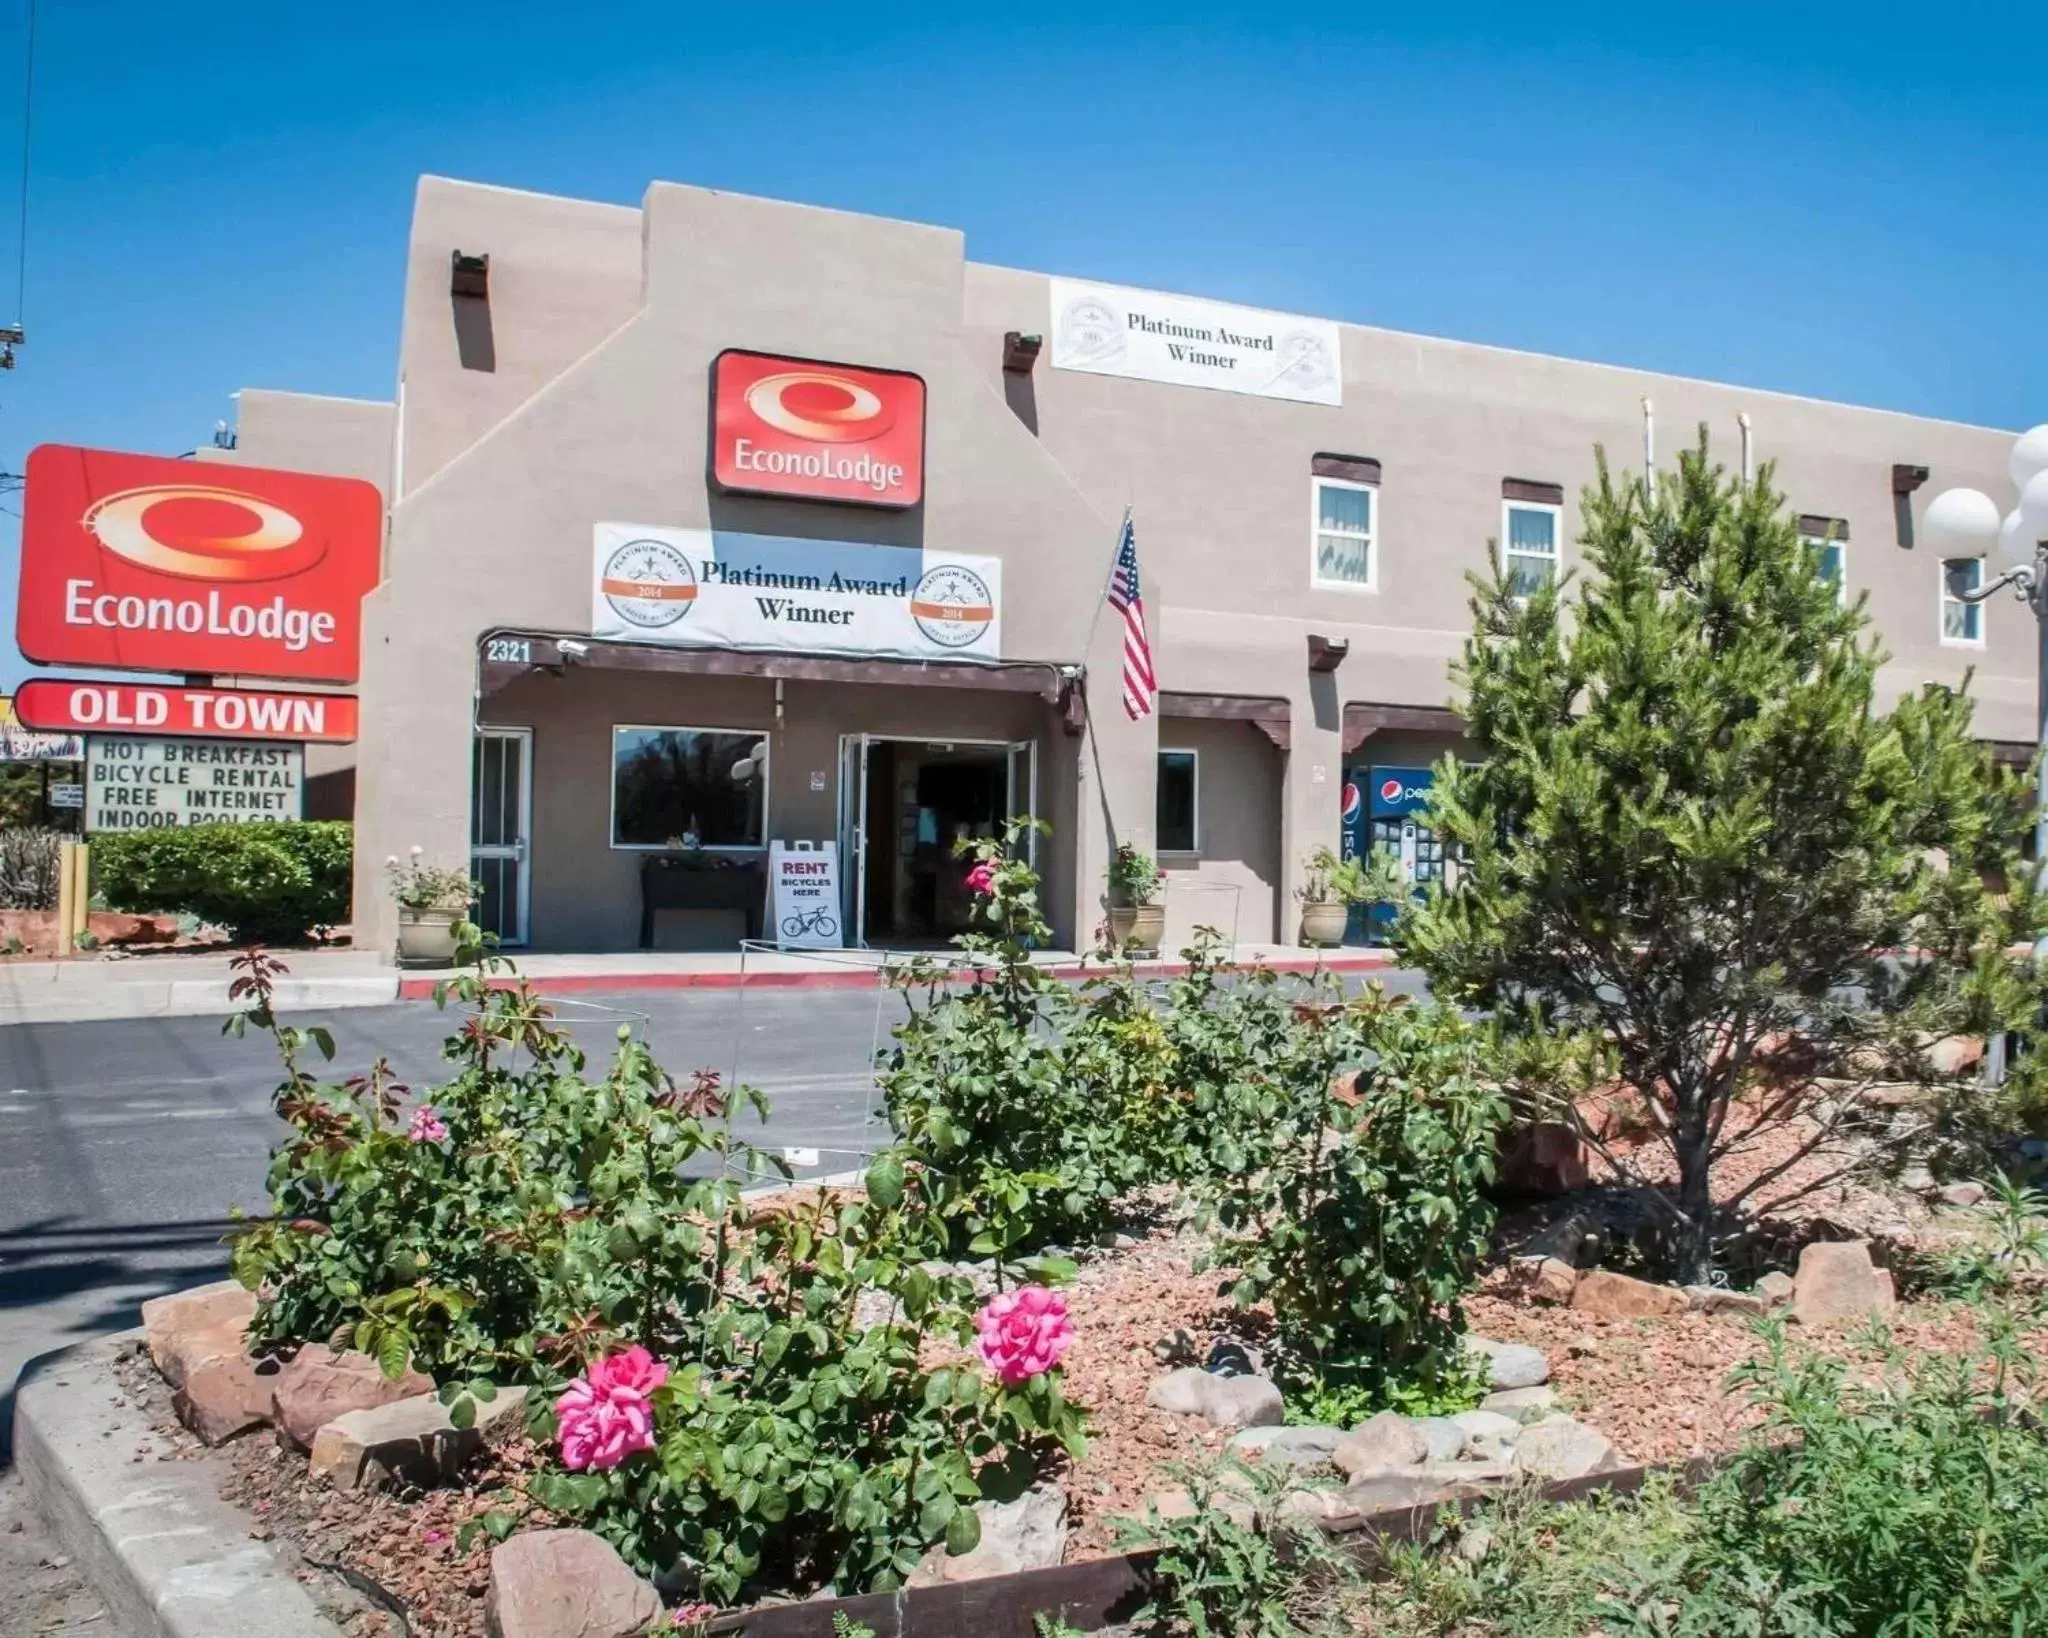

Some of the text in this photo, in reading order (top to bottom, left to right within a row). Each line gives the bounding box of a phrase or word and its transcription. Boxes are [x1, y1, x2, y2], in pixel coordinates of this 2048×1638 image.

[1127, 312, 1213, 342] Platinum
[1215, 327, 1274, 351] Award
[1167, 343, 1238, 370] Winner
[735, 438, 903, 491] EconoLodge
[701, 560, 907, 598] Platinum Award
[638, 586, 662, 598] 2014
[65, 578, 336, 651] EconoLodge
[755, 596, 855, 626] Winner
[942, 609, 963, 619] 2014
[488, 639, 530, 662] 2321
[69, 688, 325, 734] OLD TOWN
[103, 741, 149, 760] HOT
[164, 744, 293, 766] BREAKFAST
[94, 764, 296, 788] BICYCLE RENTAL
[103, 786, 287, 810] FREE INTERNET
[98, 809, 178, 829] INDOOR
[782, 862, 829, 875] RENT
[780, 878, 831, 887] BICYCLES
[792, 888, 821, 897] HERE
